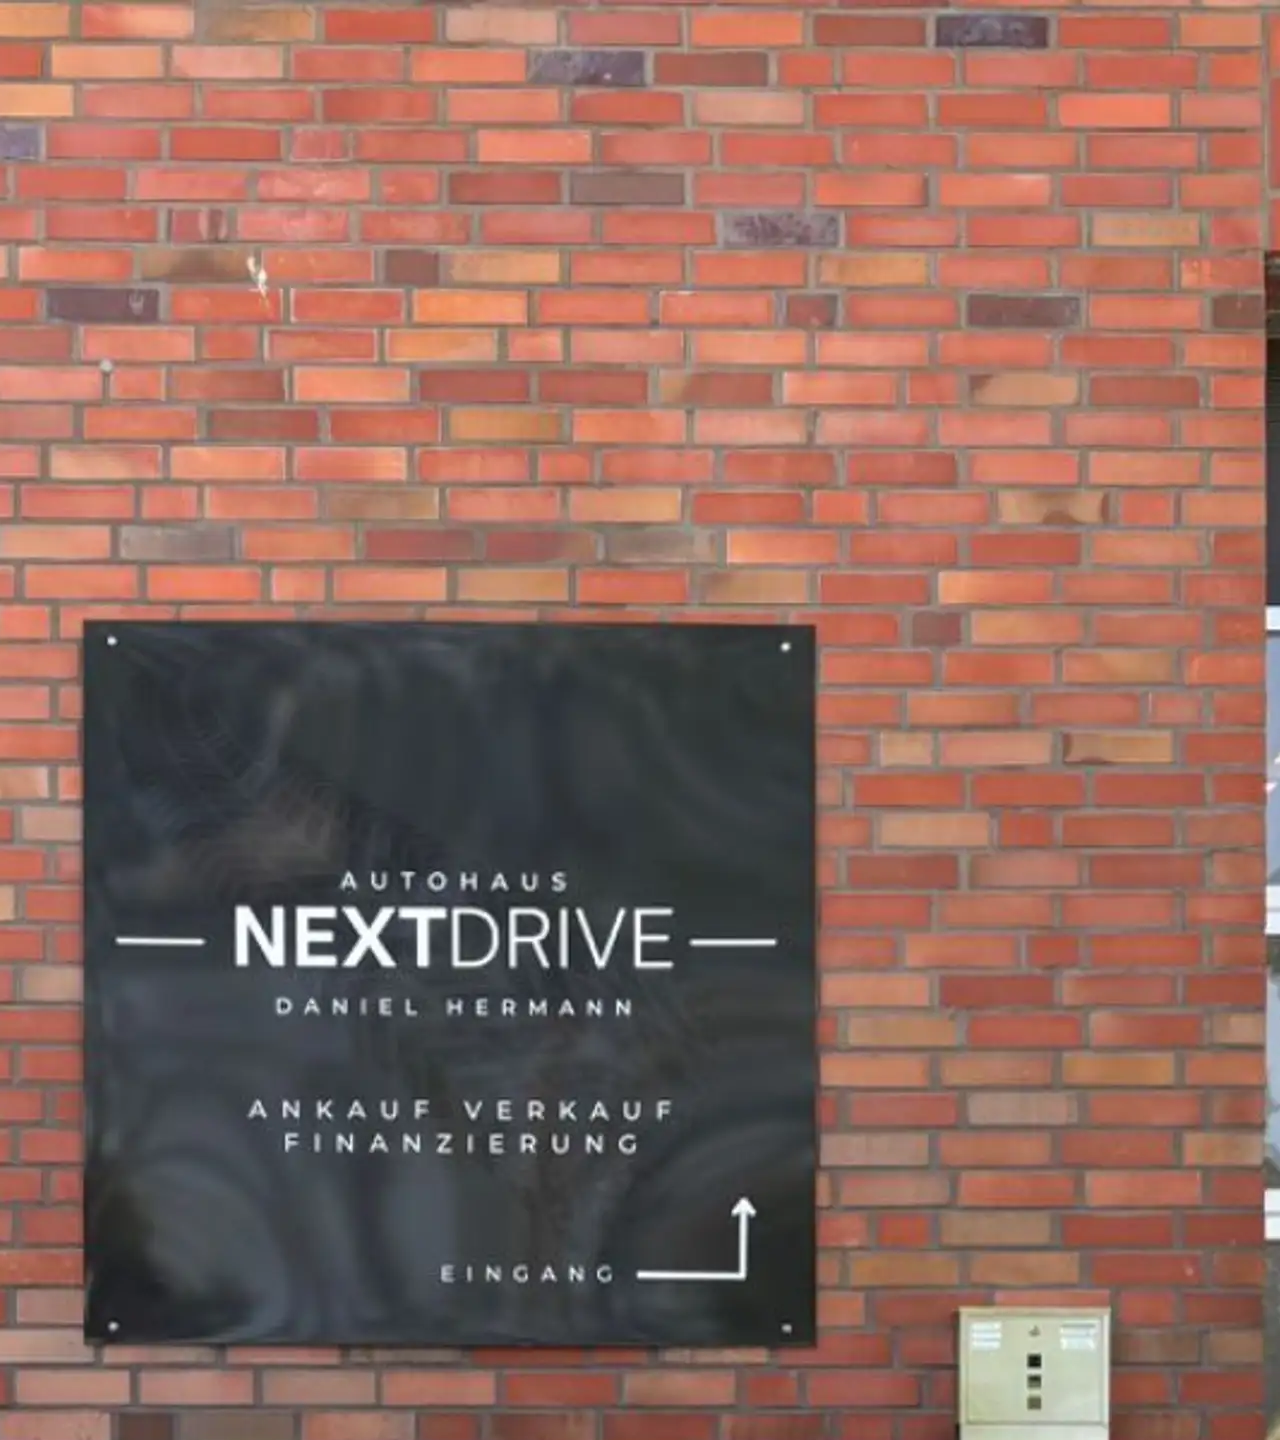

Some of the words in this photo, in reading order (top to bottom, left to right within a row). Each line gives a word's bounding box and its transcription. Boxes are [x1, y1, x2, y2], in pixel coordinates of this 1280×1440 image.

[340, 870, 568, 892] AUTOHAUS
[234, 905, 674, 970] NEXTDRIVE
[276, 997, 418, 1017] DANIEL
[447, 998, 633, 1017] HERMANN
[248, 1099, 431, 1121] ANKAUF
[464, 1100, 673, 1122] VERKAUF
[284, 1132, 638, 1155] FINANZIERUNG
[440, 1265, 614, 1283] EINGANG
